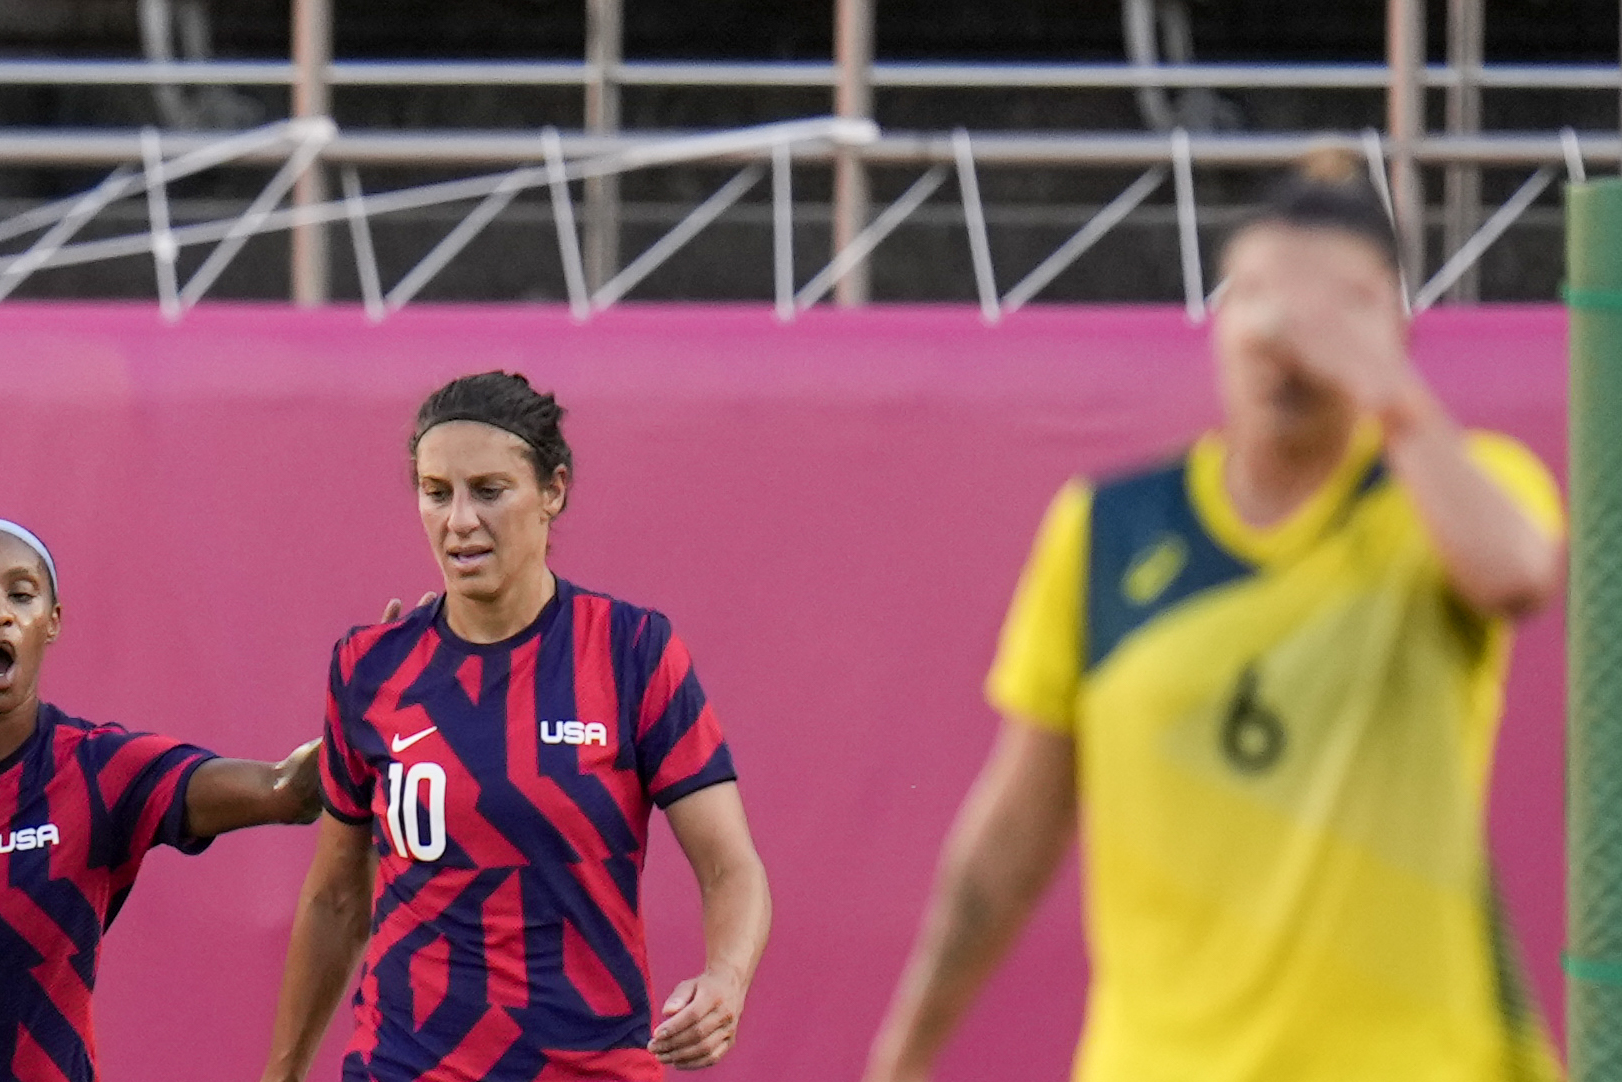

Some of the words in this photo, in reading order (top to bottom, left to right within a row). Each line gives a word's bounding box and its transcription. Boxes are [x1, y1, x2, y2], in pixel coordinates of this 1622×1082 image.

[540, 720, 607, 747] USA
[1220, 661, 1288, 778] 6
[386, 762, 447, 862] 10
